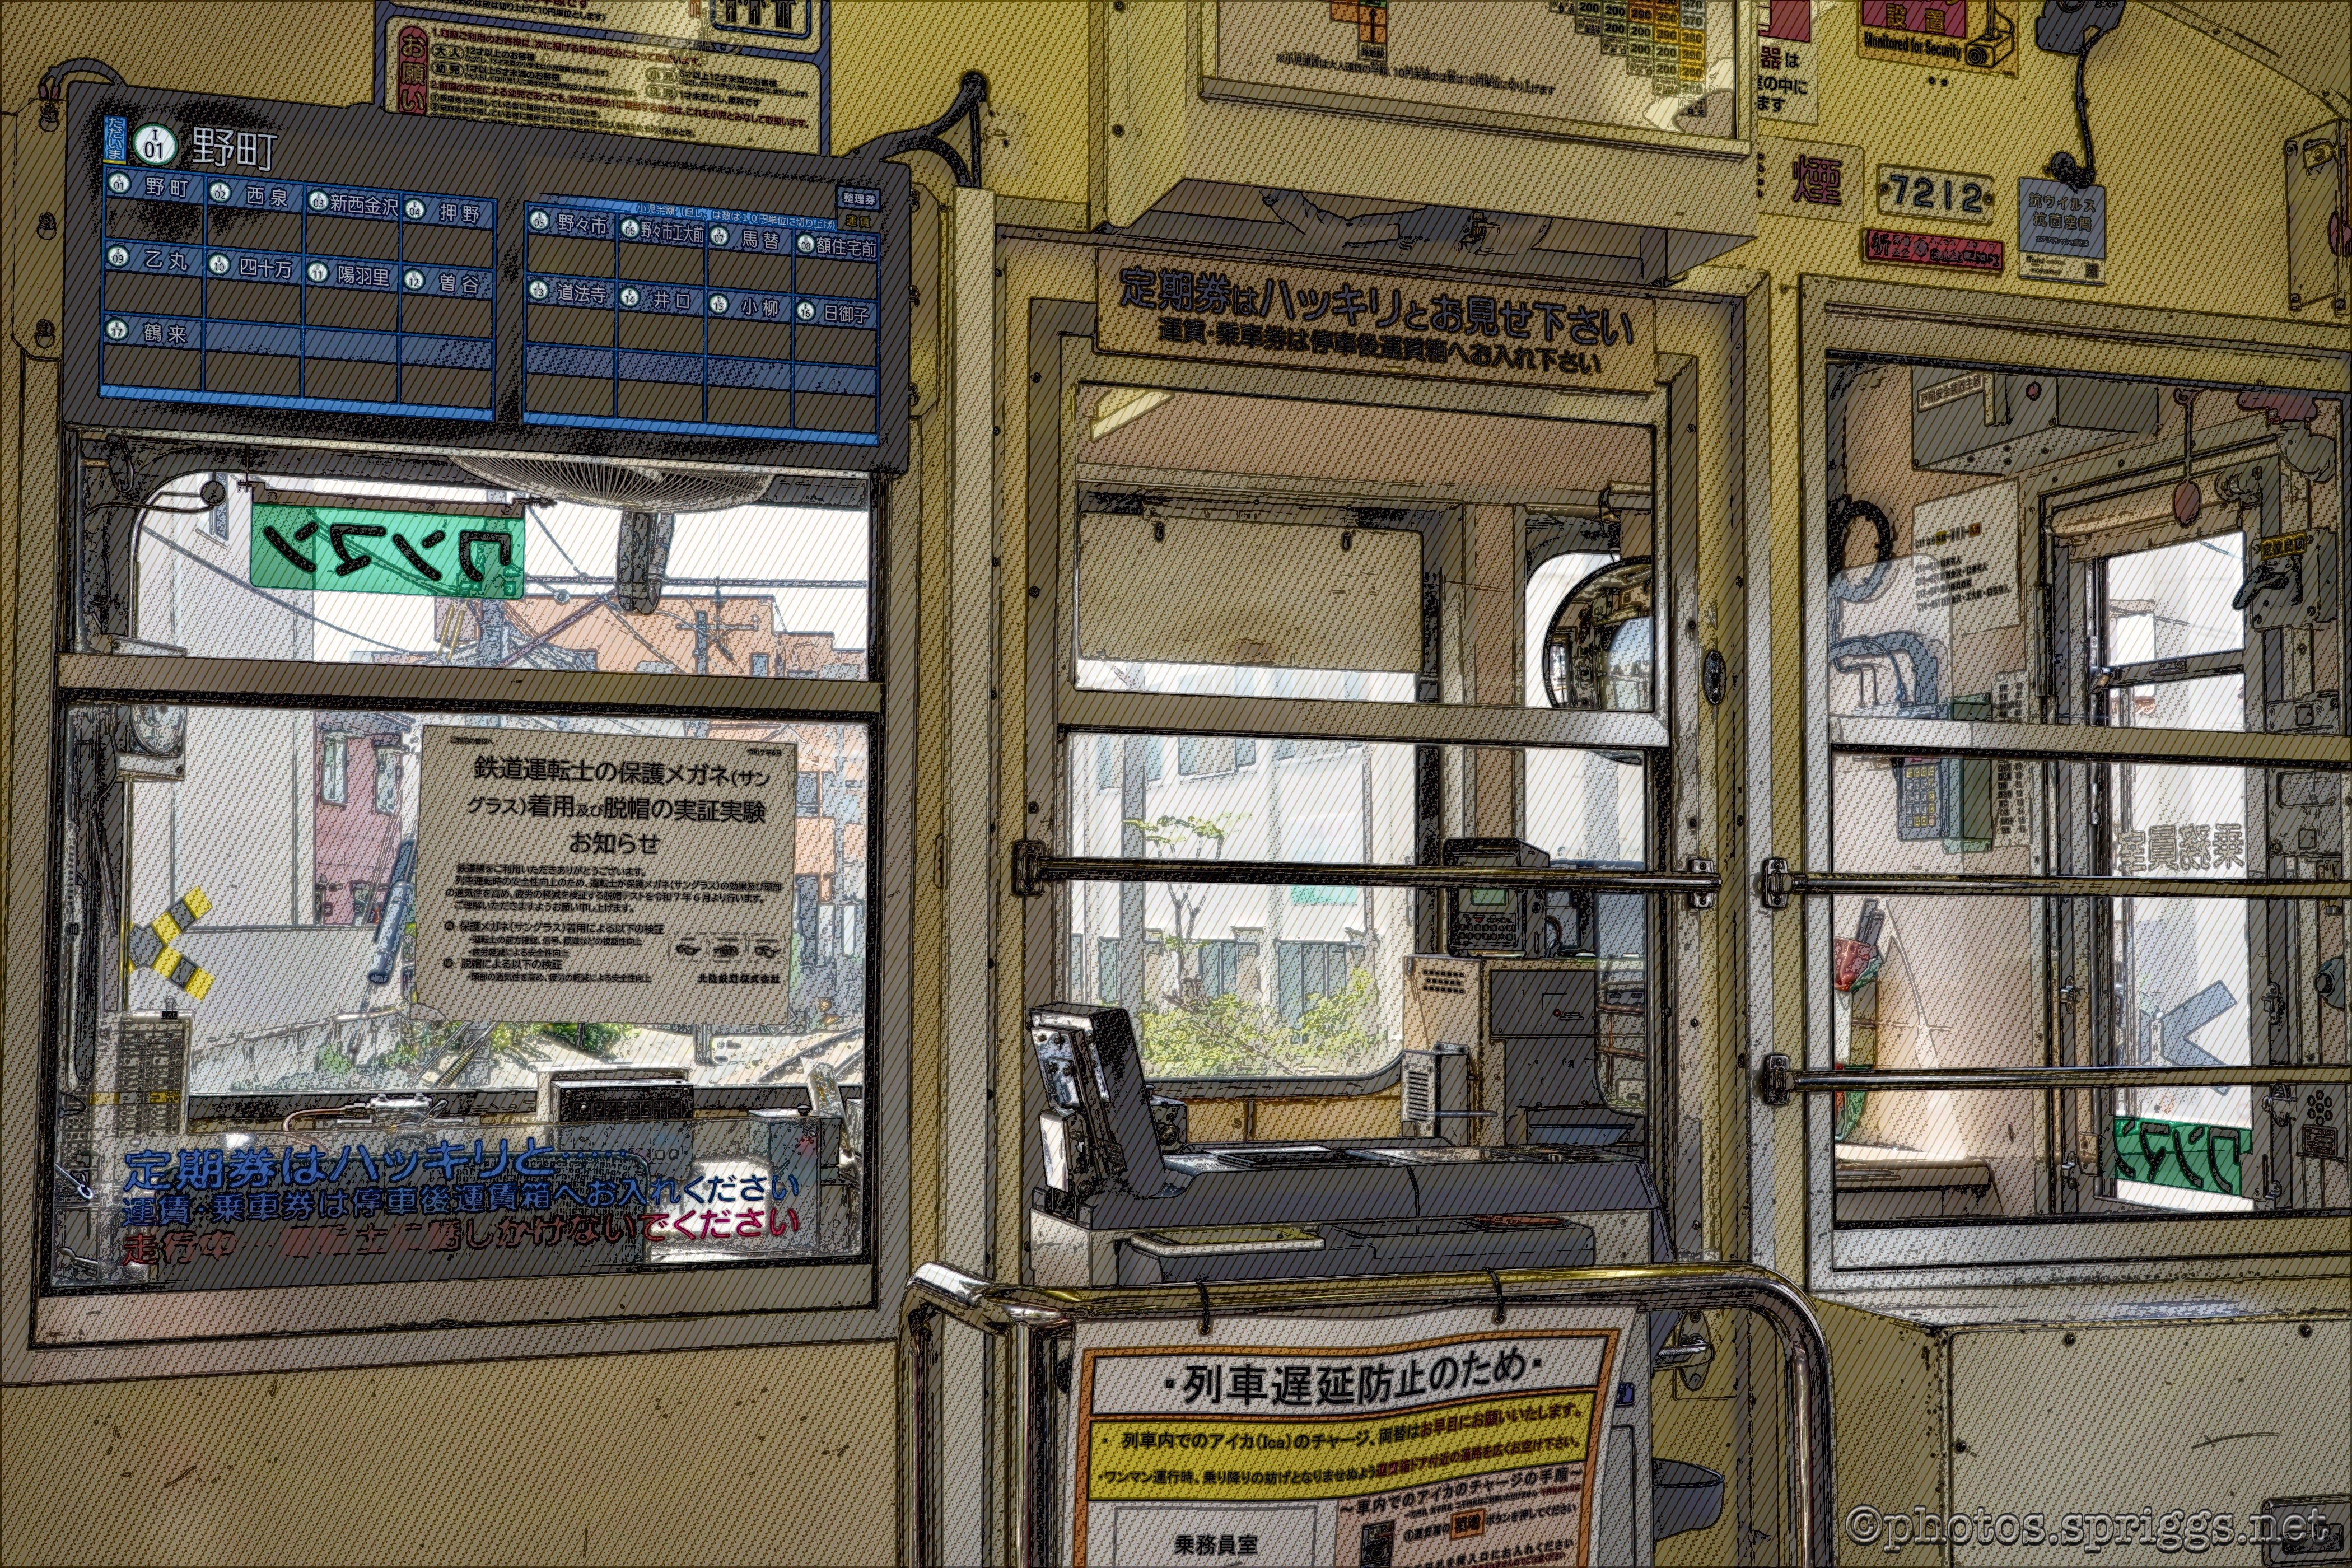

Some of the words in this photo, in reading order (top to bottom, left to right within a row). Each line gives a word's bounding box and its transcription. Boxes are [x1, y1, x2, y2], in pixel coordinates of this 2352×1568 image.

[1579, 3, 1599, 13] 200
[1606, 6, 1625, 16] 200
[1631, 10, 1651, 20] 290
[1657, 12, 1676, 22] 290
[1886, 2, 1945, 34] 設置
[1606, 23, 1625, 33] 200
[1631, 26, 1651, 36] 200
[1657, 29, 1676, 40] 290
[1683, 33, 1702, 44] 290
[1864, 32, 1908, 52] Monitored
[1911, 38, 1922, 53] for
[1925, 40, 1961, 61] Security
[437, 46, 460, 57] 大人
[465, 46, 535, 62] 12才以上のお客様
[1631, 44, 1650, 54] 200
[1657, 47, 1676, 57] 200
[1683, 50, 1702, 60] 290
[402, 35, 426, 111] お願い
[436, 63, 460, 74] 幼児
[465, 64, 559, 82] 1才以上6才未満のお客様
[650, 70, 673, 82] 小児
[679, 70, 777, 87] 6才以上12才未満のお客様
[1657, 65, 1676, 74] 200
[1683, 67, 1702, 77] 290
[679, 92, 760, 106] 1才未満とし、無料です
[108, 116, 124, 160] ただいま
[144, 142, 163, 159] 01
[192, 126, 278, 172] 野町
[146, 177, 188, 198] 野町
[246, 186, 288, 207] 西泉
[1889, 174, 1984, 213] 7212
[330, 194, 399, 216] 新西金沢
[843, 192, 876, 207] 整理券
[2029, 192, 2096, 213] 抗ウイルス
[440, 203, 480, 223] 押野
[2033, 211, 2092, 232] 抗菌空間
[558, 213, 607, 235] 野々市
[641, 221, 704, 244] 野々市工大前
[742, 230, 780, 250] 馬替
[816, 238, 876, 258] 額住宅前
[144, 250, 187, 271] 乙丸
[240, 258, 292, 279] 四十万
[338, 265, 390, 287] 陽羽里
[558, 283, 607, 304] 道法寺
[654, 292, 690, 310] 井口
[742, 296, 780, 317] 小柳
[824, 303, 869, 324] 日御子
[1120, 265, 1634, 348] 定期券はハッキリとお見せ下さい
[143, 324, 186, 343] 鶴来
[1159, 318, 1602, 375] 運賃・乗車券は停車後運賃箱へお入れ下さい
[450, 737, 493, 745] ご利用の皆様へ
[474, 755, 770, 787] 鉄道運転士の保護メガネ(サン
[468, 794, 766, 824] グラス)着用及び脱帽の実証実験
[570, 831, 661, 855] お知らせ
[457, 863, 646, 876] 鉄道線をご利用いただきありがとうございます。
[454, 901, 633, 914] ご理解いただきますようお願い申し上げます。
[461, 959, 562, 970] 脱帽による以下の検証
[122, 1173, 800, 1228] 運賃・乗車券は停車後運賃箱へお入れください
[1540, 1484, 1581, 1496] 千円札のみ対応
[1486, 1503, 1576, 1525] ボタンを押してください
[1175, 1534, 1258, 1556] 乗務員室
